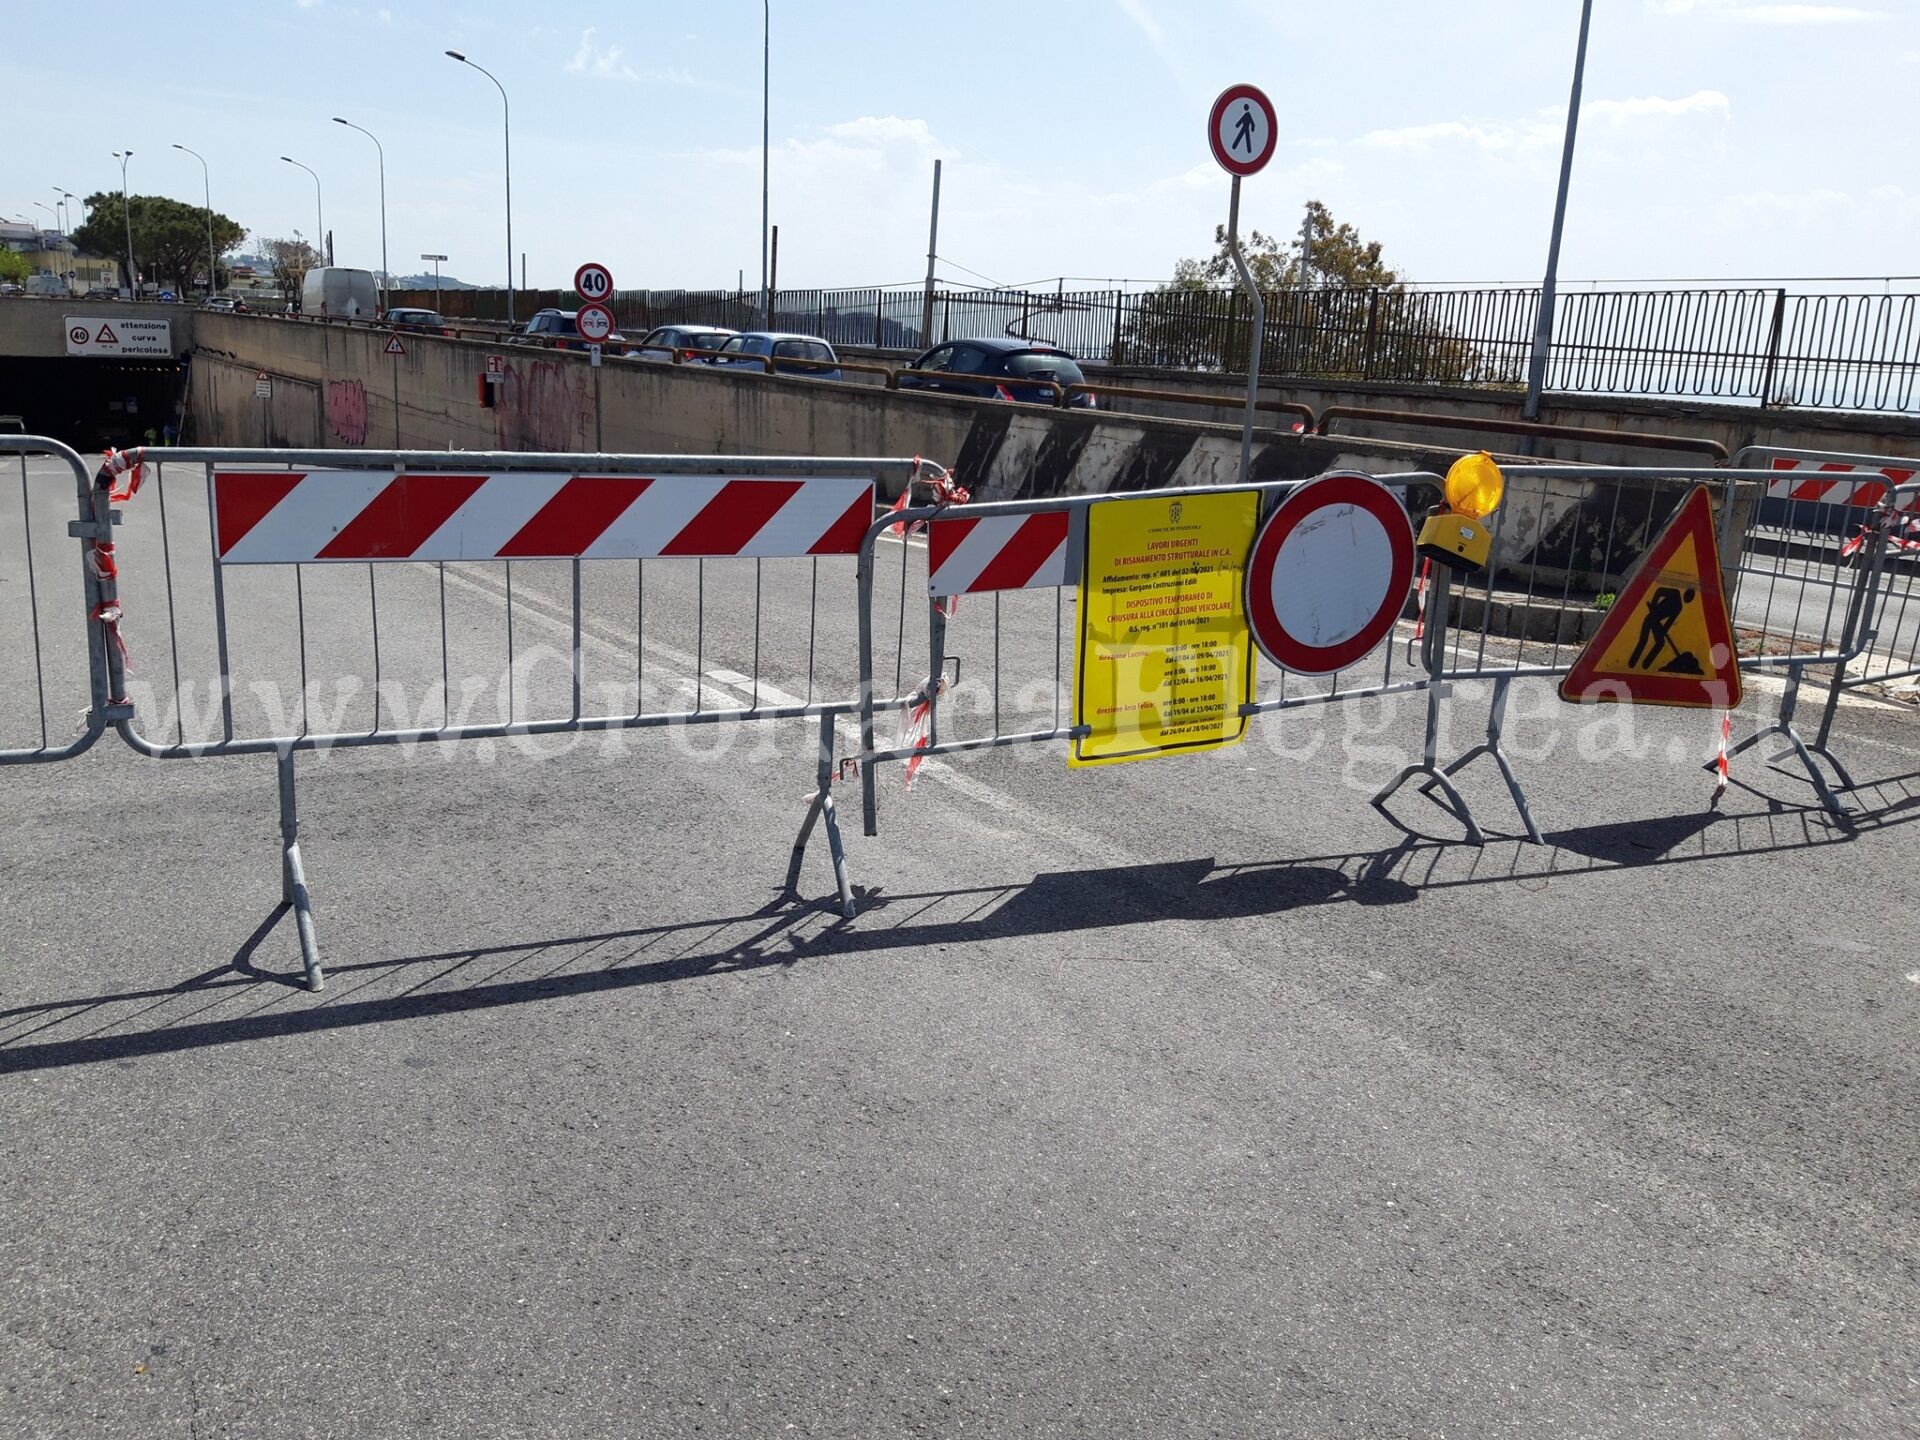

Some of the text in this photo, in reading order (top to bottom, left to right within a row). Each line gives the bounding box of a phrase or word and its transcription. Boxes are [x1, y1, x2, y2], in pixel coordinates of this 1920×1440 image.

[582, 273, 606, 292] 40
[120, 321, 167, 330] attenzione
[73, 331, 86, 341] 40
[121, 346, 168, 354] pericolosa
[1147, 538, 1198, 550] LAVORI URGENTI
[1114, 548, 1232, 566] DI RISANAMENTO STRUTTURALE IN C.A.
[1102, 574, 1140, 583] Affidamento:
[1102, 578, 1198, 595] Impresa: Gargano Costruzioni Edili
[1126, 592, 1213, 608] DISPOSITIVO TEMPORANEO DI
[1107, 601, 1232, 623] CHIUSURA ALLA CIRCOLAZIONE VEICOLARE
[1169, 619, 1179, 628] del
[1179, 617, 1210, 627] 01/04/2021
[1201, 640, 1218, 648] 18:00
[1098, 652, 1127, 661] direzione
[1196, 650, 1229, 660] 09/04/2021
[1200, 664, 1217, 672] 18:00
[1173, 677, 1189, 686] 12/04
[1196, 673, 1228, 683] 16/04/2021
[1173, 697, 1185, 706] 8:00
[1200, 694, 1216, 702] 18:00
[1096, 706, 1123, 715] direzione
[1123, 704, 1137, 712] Arco
[1173, 707, 1190, 716] 19/04
[1196, 703, 1228, 713] 23/04/2021
[1169, 726, 1185, 735] 26/04
[1192, 722, 1223, 732] 28/04/2021
